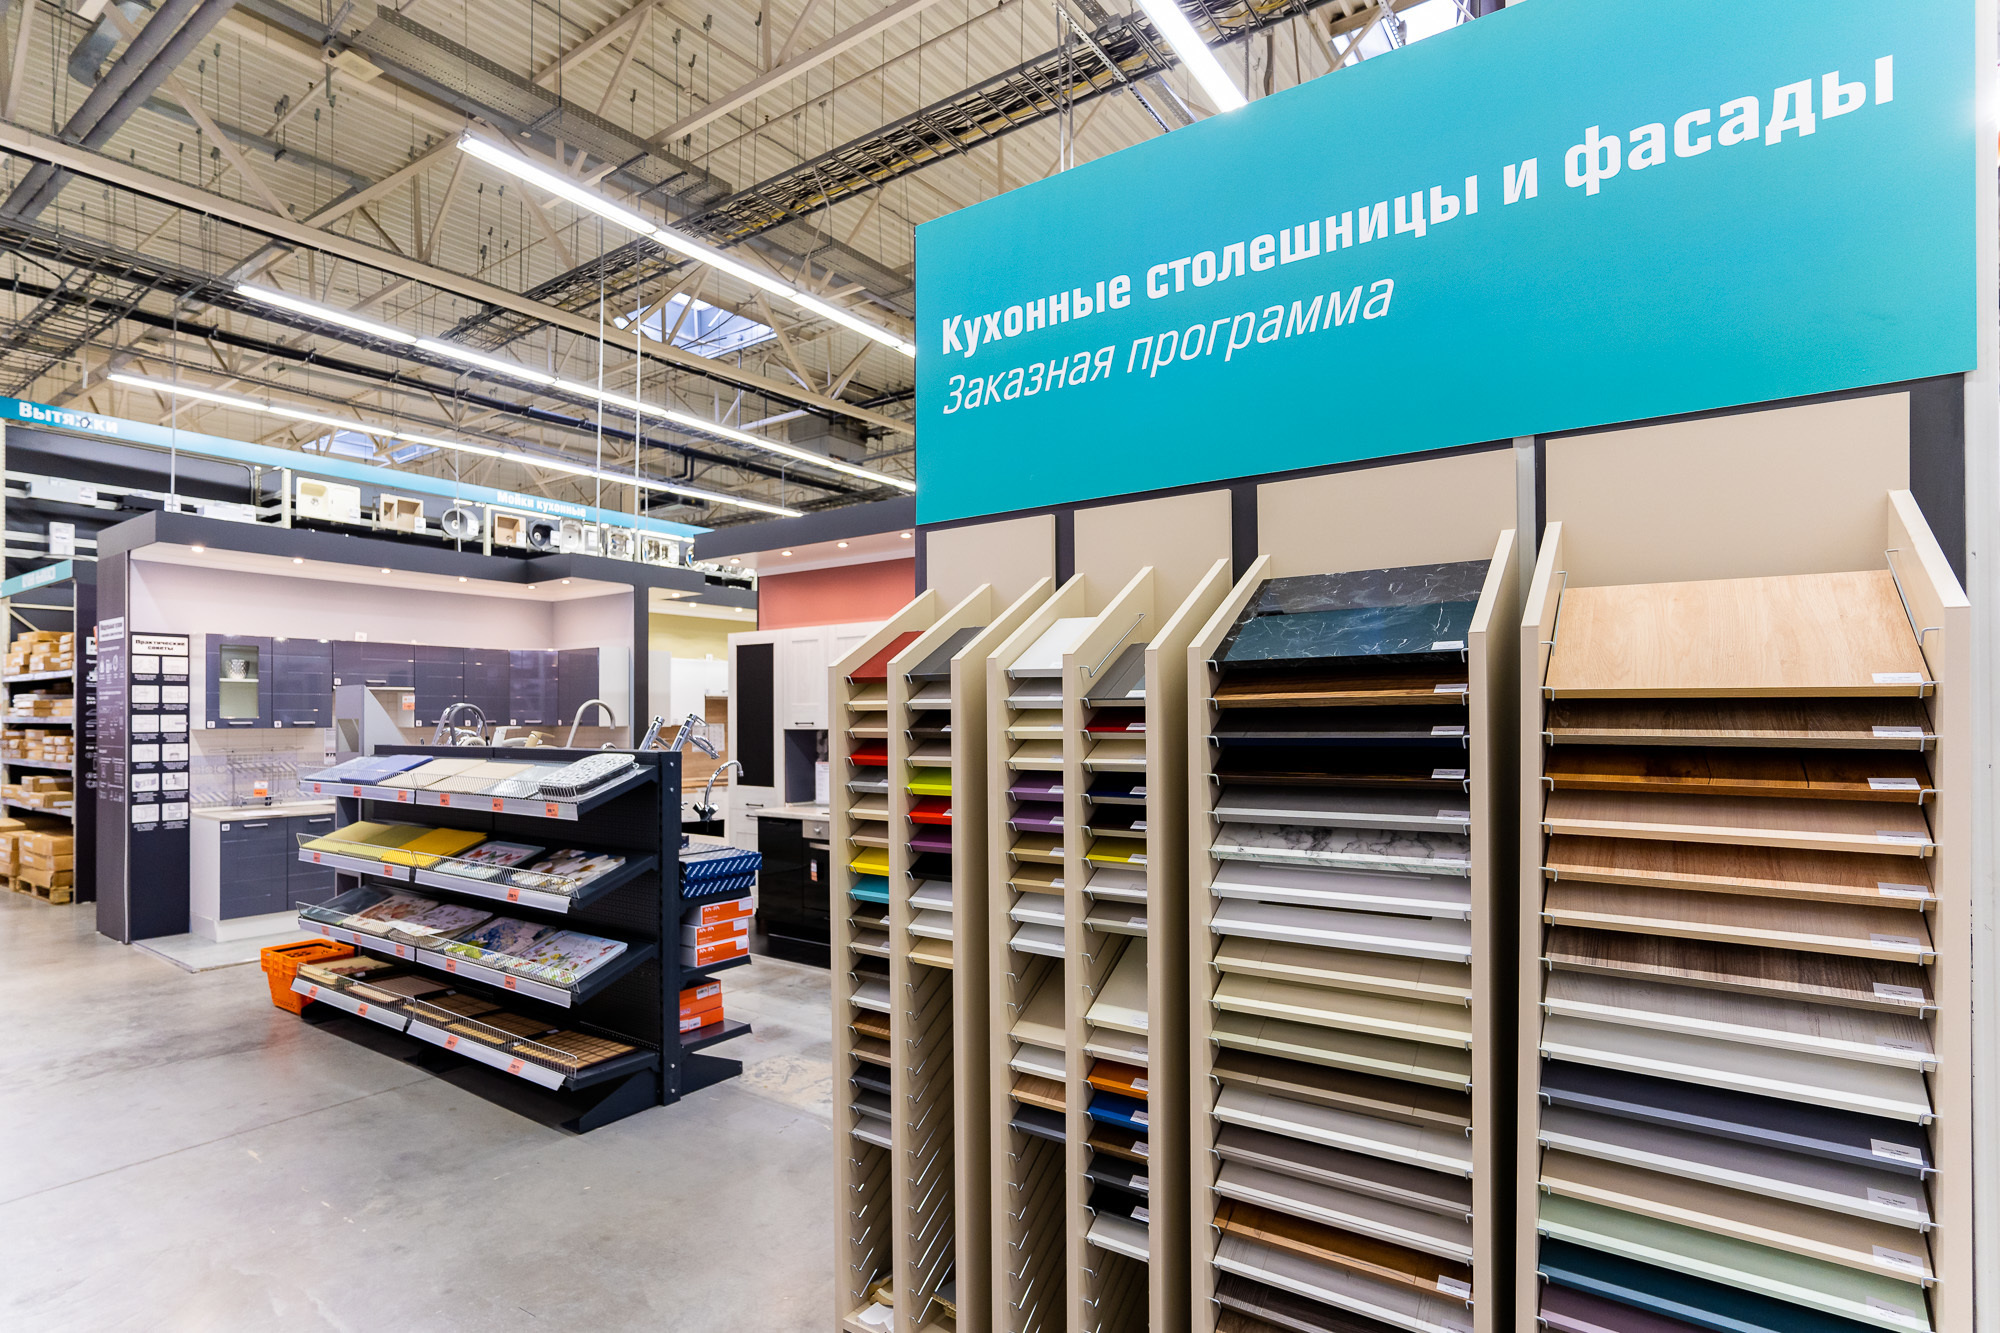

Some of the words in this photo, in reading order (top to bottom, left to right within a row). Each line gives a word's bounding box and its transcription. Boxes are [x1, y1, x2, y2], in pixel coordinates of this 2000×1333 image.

[942, 274, 1131, 357] Кухонные
[1146, 174, 1478, 299] столешницы
[1503, 157, 1538, 206] и
[1564, 54, 1894, 197] фасады
[943, 345, 1116, 414] Заказная
[1126, 278, 1395, 378] программа
[496, 490, 534, 508] Мойки
[536, 500, 586, 517] кухонные
